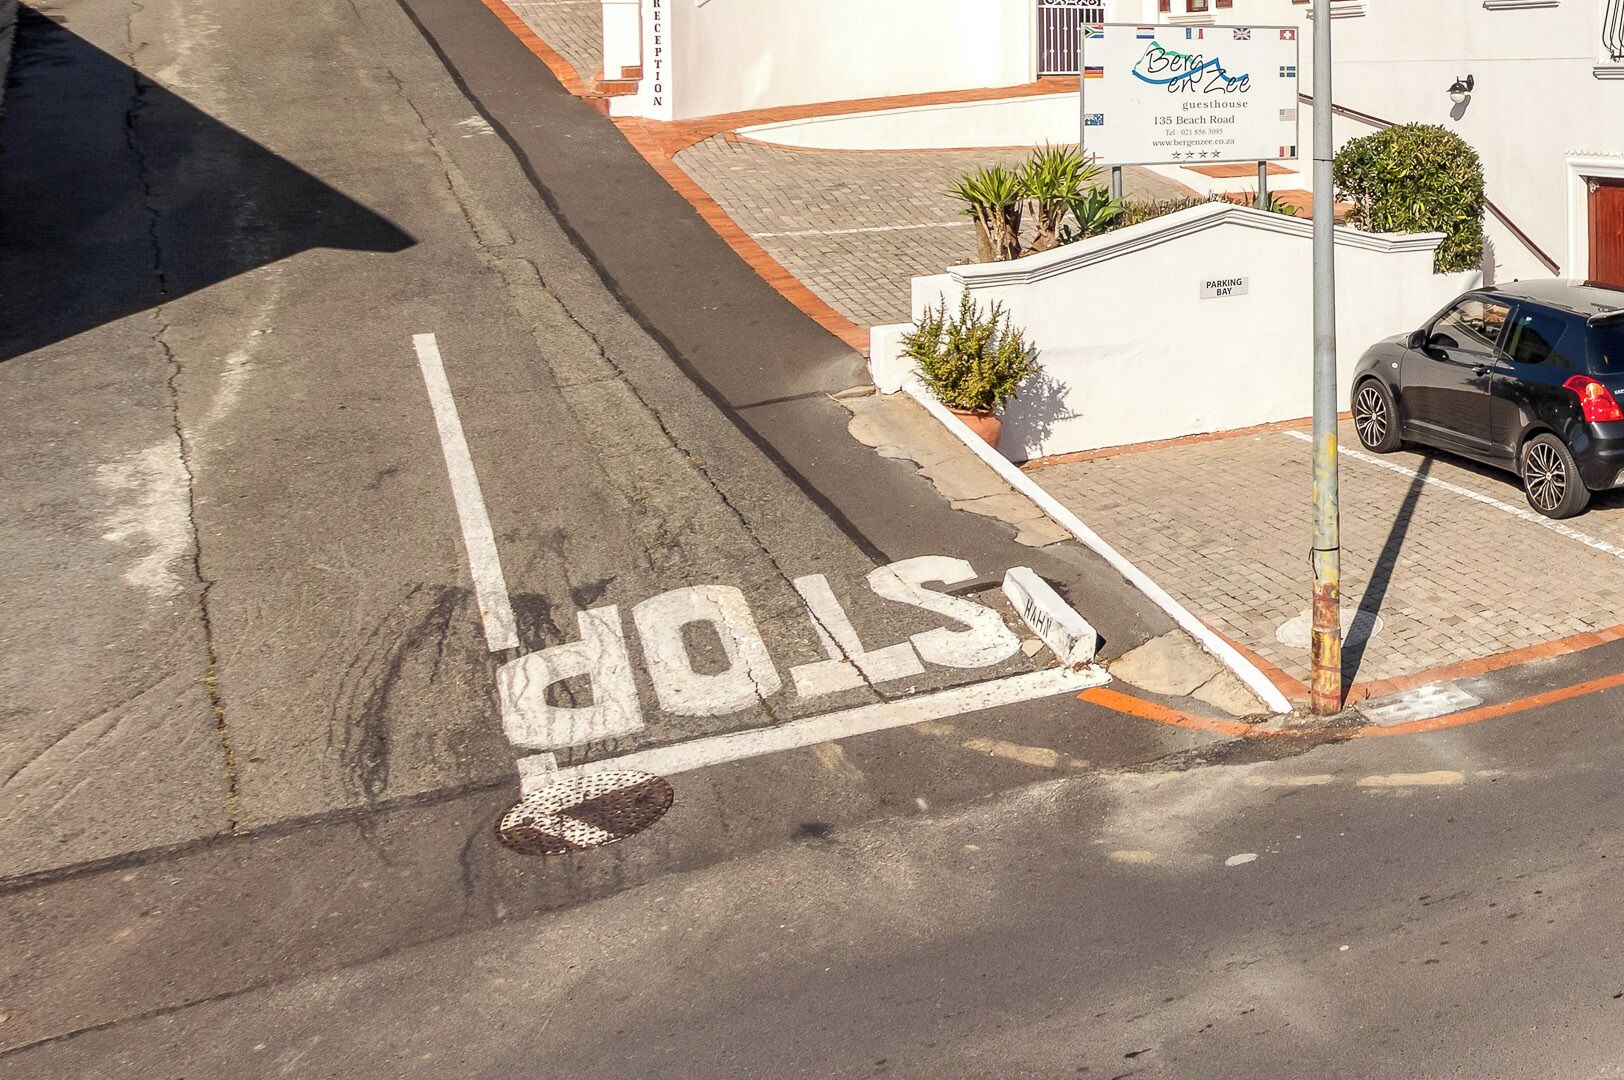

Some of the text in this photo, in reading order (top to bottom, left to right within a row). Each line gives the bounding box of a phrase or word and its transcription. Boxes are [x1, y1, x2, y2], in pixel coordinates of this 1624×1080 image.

[1146, 47, 1204, 83] Berg
[1168, 69, 1251, 94] en Zee
[1182, 99, 1248, 111] guesthouse
[1153, 115, 1235, 125] 135 Beach Road
[1152, 138, 1235, 147] www.bergenzee.co.za
[1206, 277, 1242, 289] PARKING
[1216, 287, 1232, 296] BAY
[496, 555, 1021, 749] STOP
